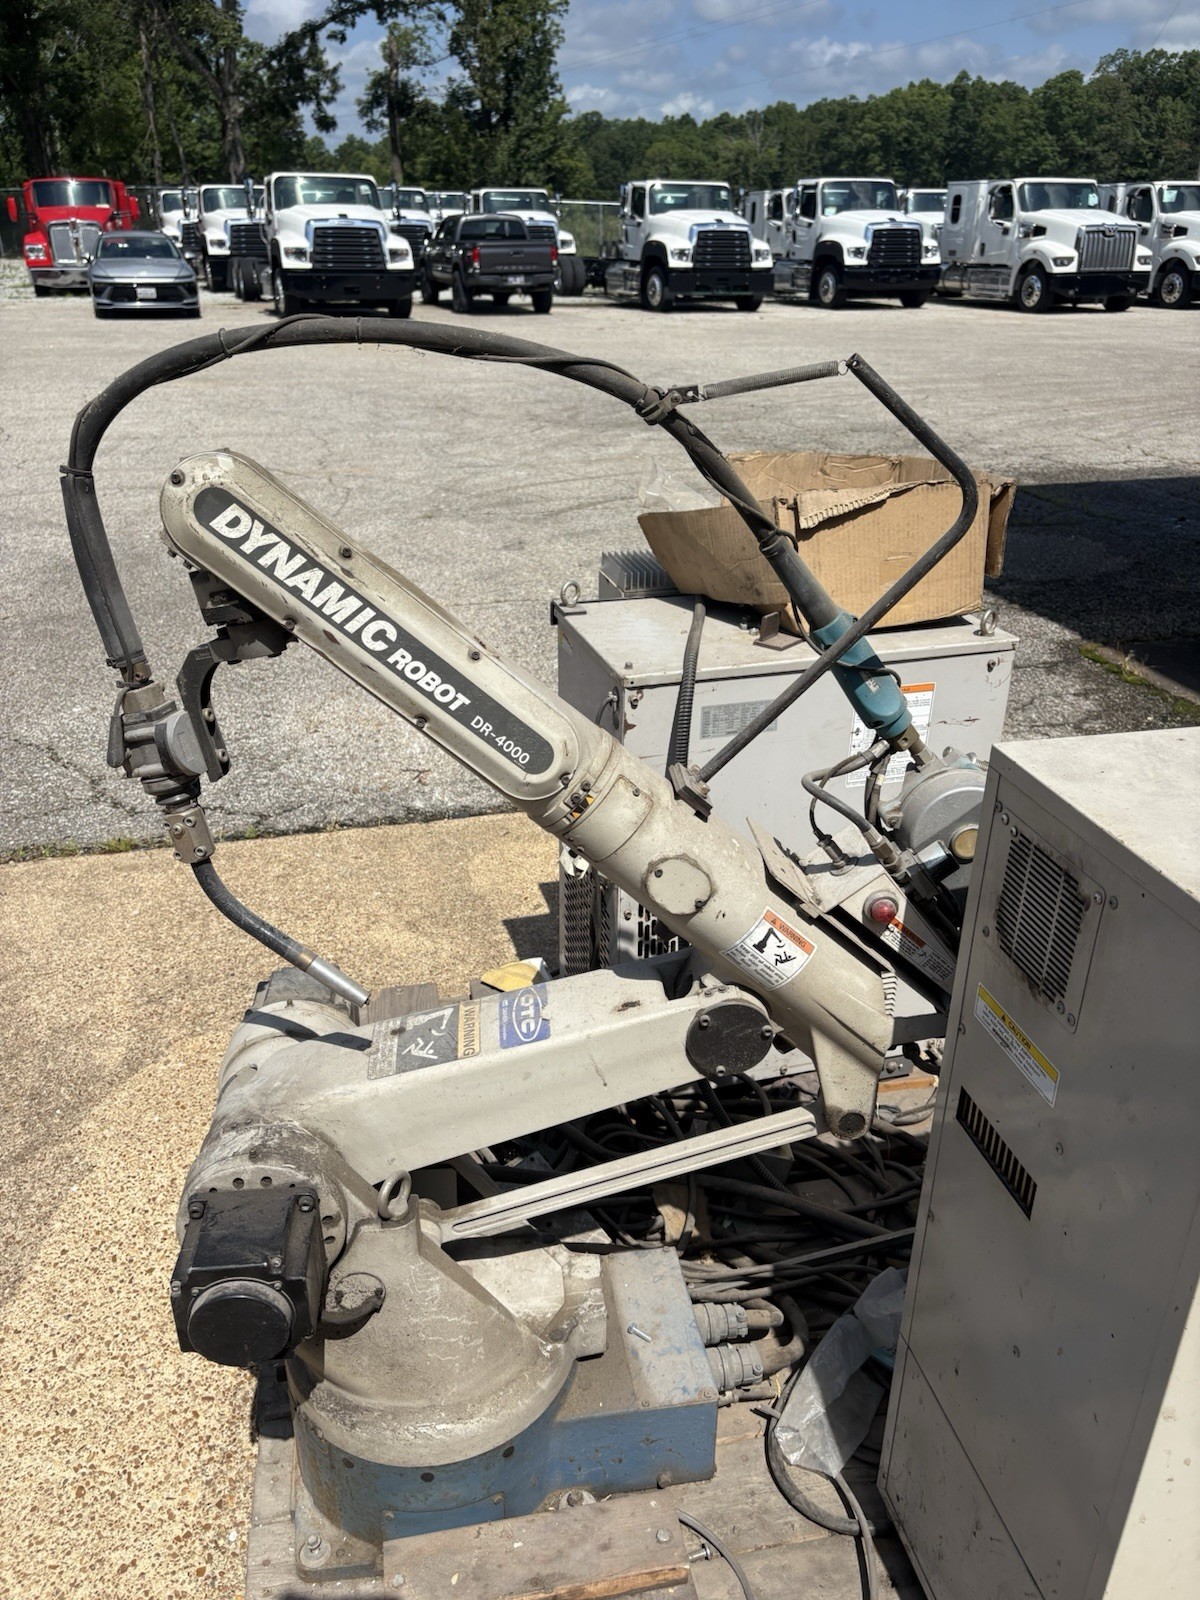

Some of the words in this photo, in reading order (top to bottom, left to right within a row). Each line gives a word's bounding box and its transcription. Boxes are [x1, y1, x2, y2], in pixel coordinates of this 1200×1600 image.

[209, 503, 397, 652] DYNAMIC
[387, 648, 470, 712] ROBOT
[470, 715, 530, 764] DR-4000
[779, 924, 806, 949] WARNING
[464, 1006, 475, 1057] WARNING
[519, 993, 536, 1034] OTC
[1008, 1021, 1031, 1050] CAUTION
